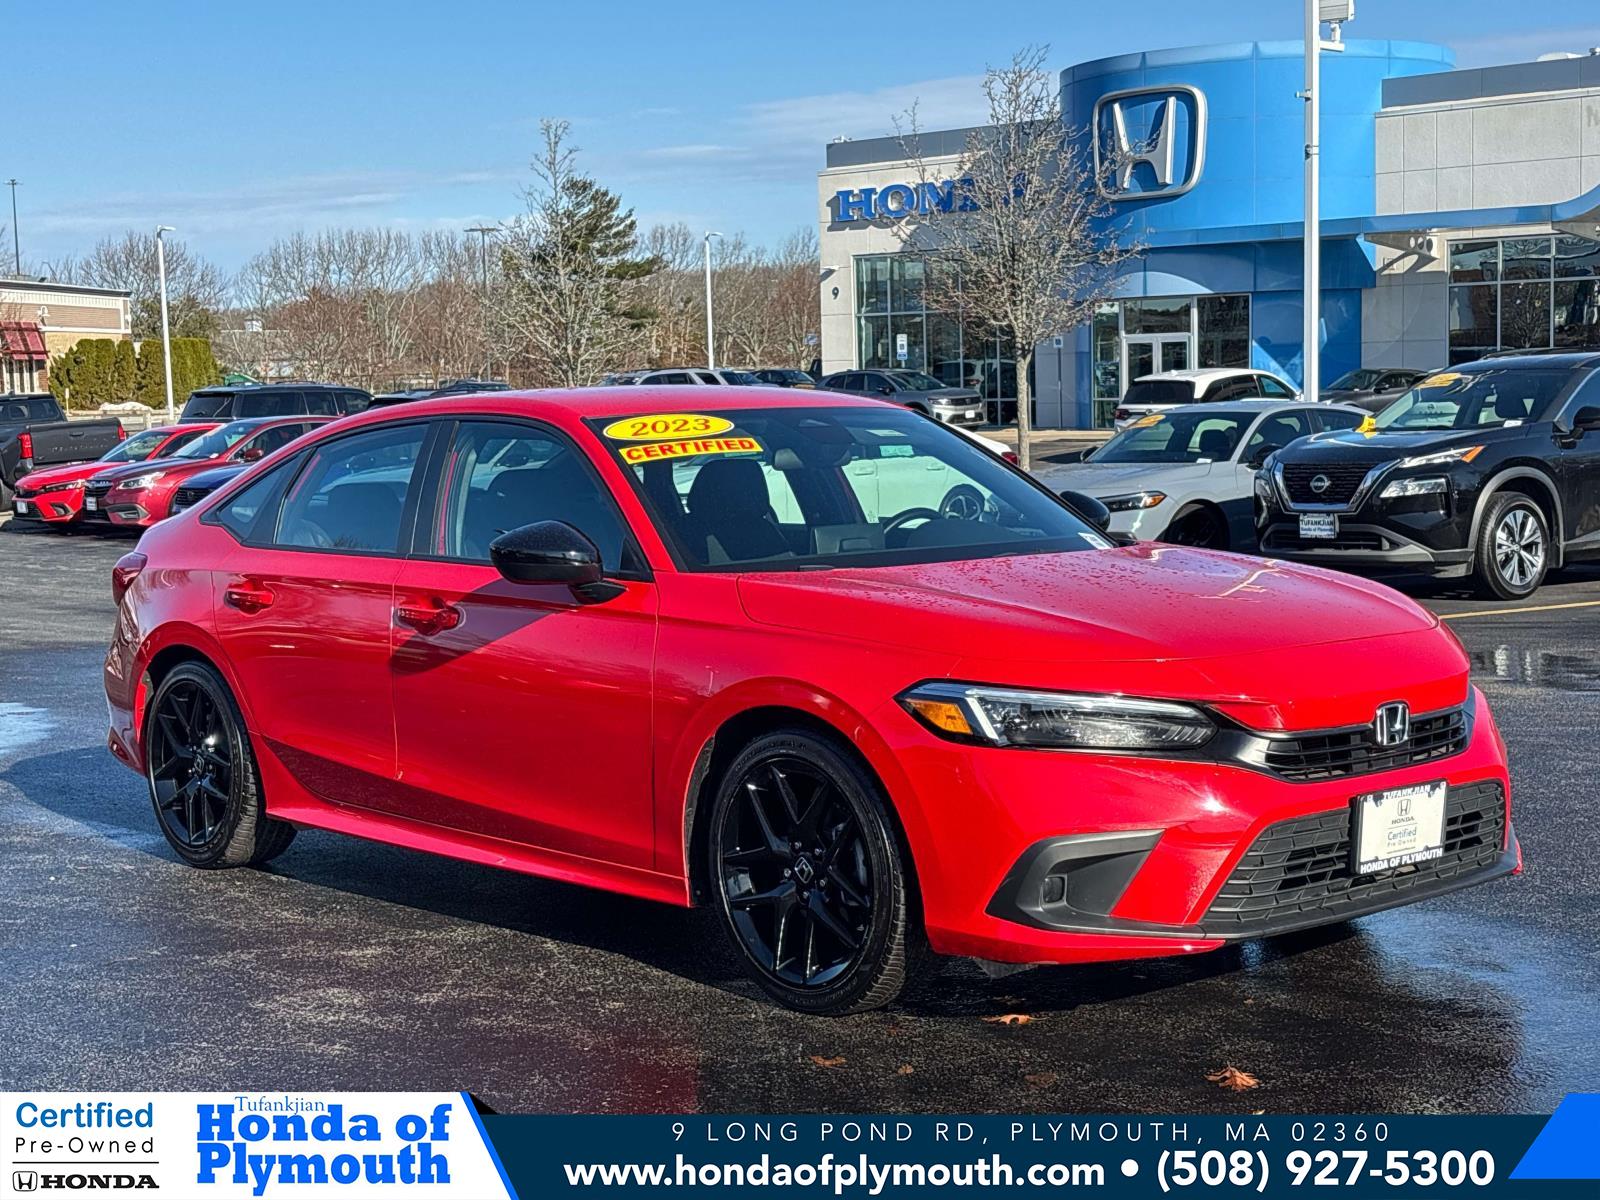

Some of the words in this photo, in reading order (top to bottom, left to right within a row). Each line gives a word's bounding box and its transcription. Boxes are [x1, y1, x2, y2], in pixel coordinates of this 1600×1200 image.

[831, 286, 840, 300] 9
[631, 418, 711, 437] 2023
[625, 438, 755, 461] CERTIFIED
[1391, 816, 1415, 825] HONDA
[1387, 826, 1417, 841] Certified
[1360, 859, 1389, 875] HONDA
[1389, 857, 1401, 868] OF
[1402, 847, 1443, 865] PLYMOUTH
